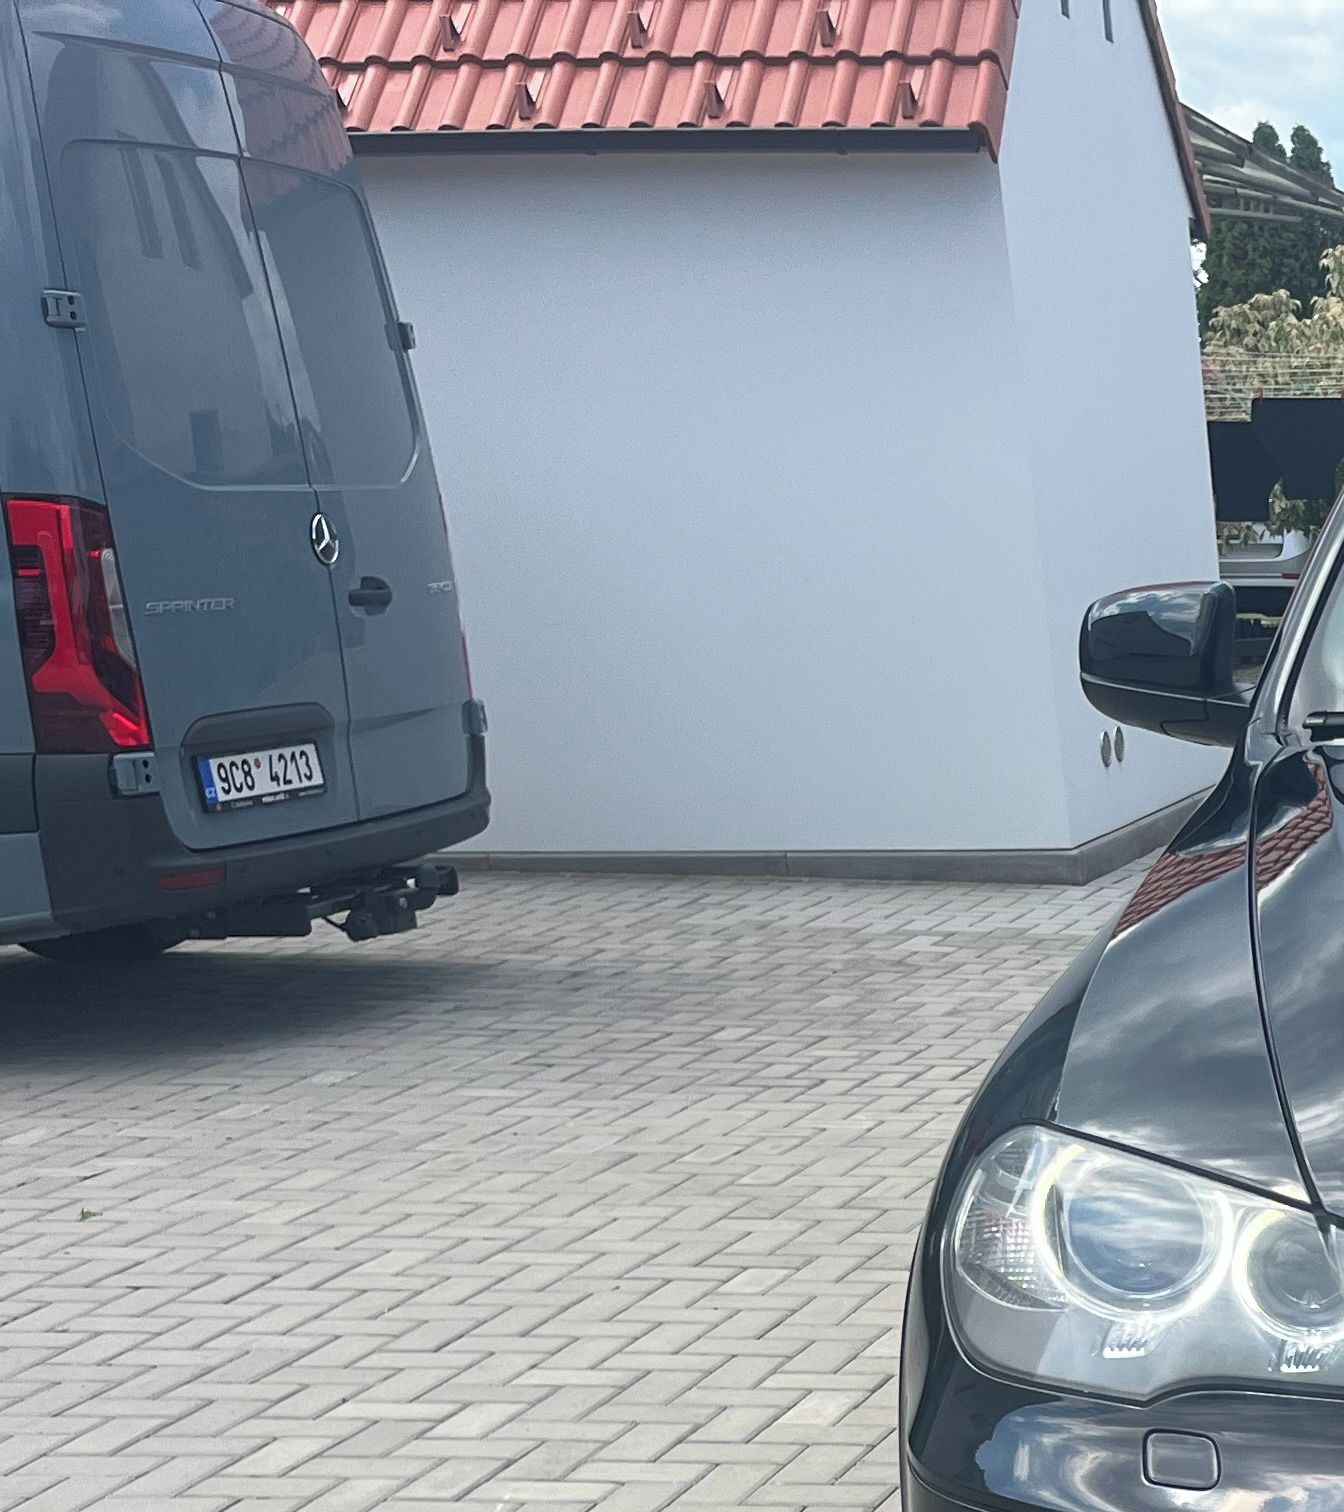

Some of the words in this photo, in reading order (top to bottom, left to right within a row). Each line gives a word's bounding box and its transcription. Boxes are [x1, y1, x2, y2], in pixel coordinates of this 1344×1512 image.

[144, 597, 235, 616] SPRINTER
[216, 758, 255, 795] 9C8
[269, 749, 313, 787] 4213
